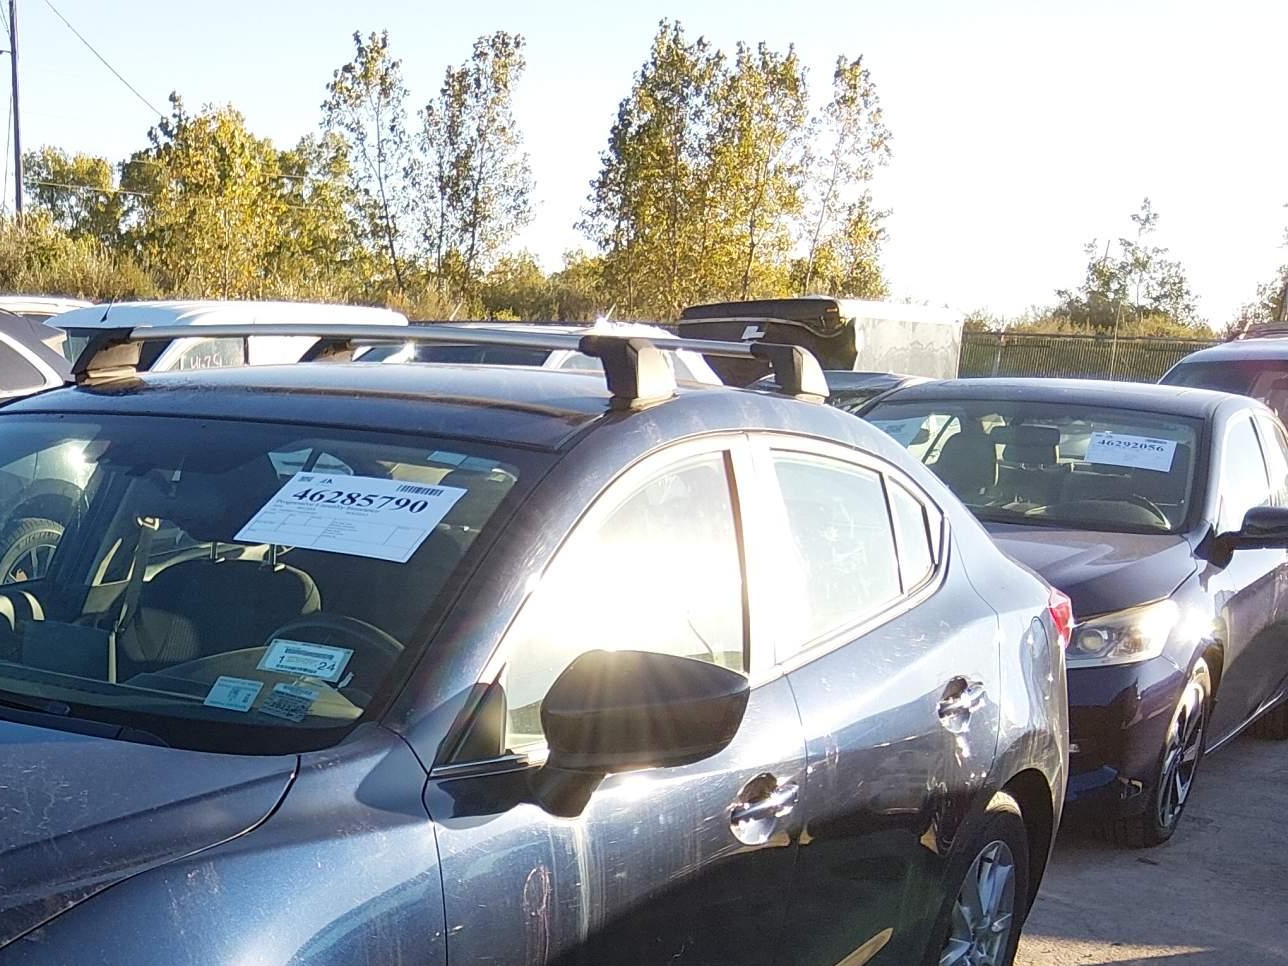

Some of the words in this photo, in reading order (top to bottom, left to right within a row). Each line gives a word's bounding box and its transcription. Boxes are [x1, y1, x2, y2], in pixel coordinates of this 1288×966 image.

[1097, 438, 1165, 453] 46292056
[292, 487, 429, 514] 46285790
[317, 661, 337, 672] 24
